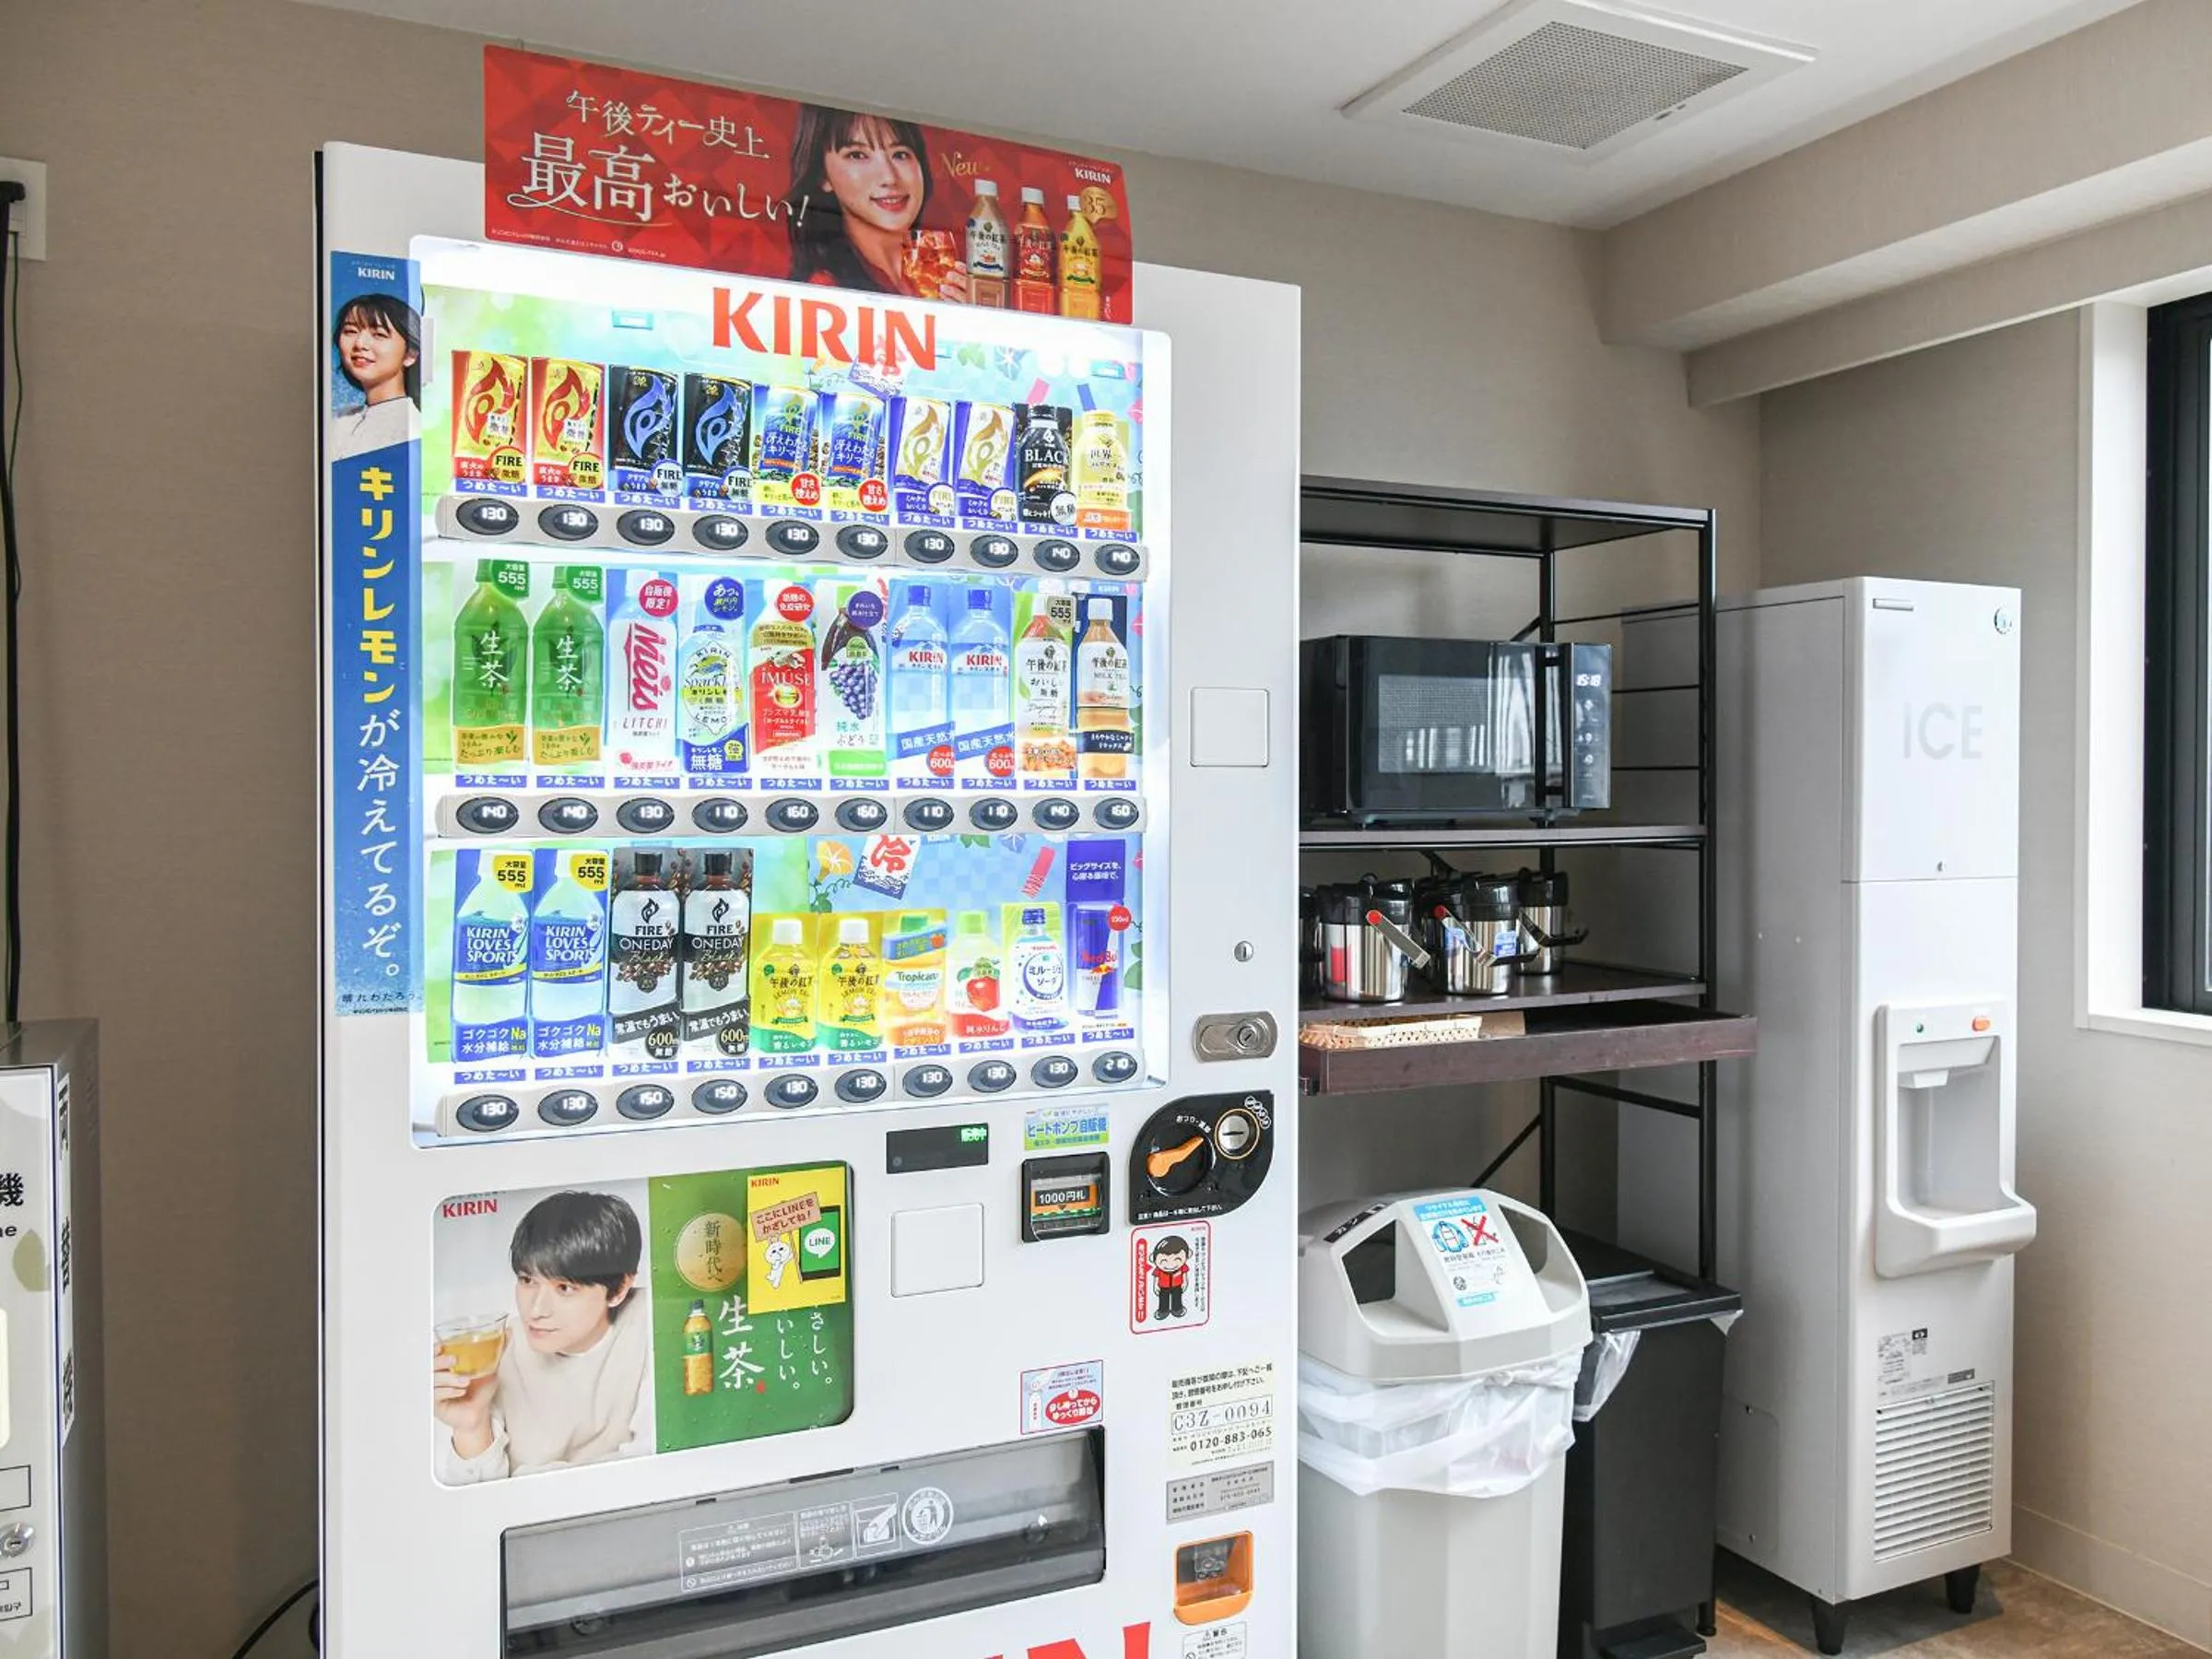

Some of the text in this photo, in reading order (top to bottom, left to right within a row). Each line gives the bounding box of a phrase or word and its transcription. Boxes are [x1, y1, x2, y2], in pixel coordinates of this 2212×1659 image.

[566, 89, 771, 159] 午後ティー史上
[1074, 167, 1112, 185] KIRIN
[357, 266, 396, 281] KIRIN
[712, 287, 936, 371] KIRIN
[496, 455, 523, 467] FIRE
[572, 461, 600, 473] FIRE
[498, 571, 526, 584] 555
[571, 577, 598, 590] 555
[1051, 606, 1072, 618] 555
[478, 629, 510, 688] 生茶
[555, 635, 582, 691] 生茶
[908, 651, 944, 664] KIRIN
[966, 653, 1003, 666] KIRIN
[356, 466, 402, 977] キリンレモンが冷えてるぞ。
[1902, 701, 1983, 760] ICE
[498, 869, 526, 882] 555
[577, 866, 606, 878] 555
[466, 925, 510, 938] KIRIN
[546, 924, 586, 937] KIRIN
[635, 925, 664, 935] FIRE
[706, 924, 734, 935] FIRE
[467, 938, 512, 950] LOVES
[546, 937, 588, 949] LOVES
[618, 937, 675, 951] ONEDAY
[692, 936, 744, 950] ONEDAY
[466, 949, 518, 964] SPORTS
[545, 948, 595, 961] SPORTS
[463, 1027, 510, 1041] ゴクゴク
[538, 1025, 585, 1038] ゴクゴク
[751, 1177, 780, 1188] KIRIN
[1039, 1189, 1087, 1205] 1000円札
[441, 1198, 498, 1218] KIRIN
[808, 1236, 831, 1248] LINE
[719, 1294, 766, 1390] 生茶
[810, 1305, 832, 1384] さしい。
[776, 1309, 801, 1390] いしい。
[1174, 1399, 1270, 1431] C3Z-0094
[1189, 1426, 1272, 1452] 0120-883-065
